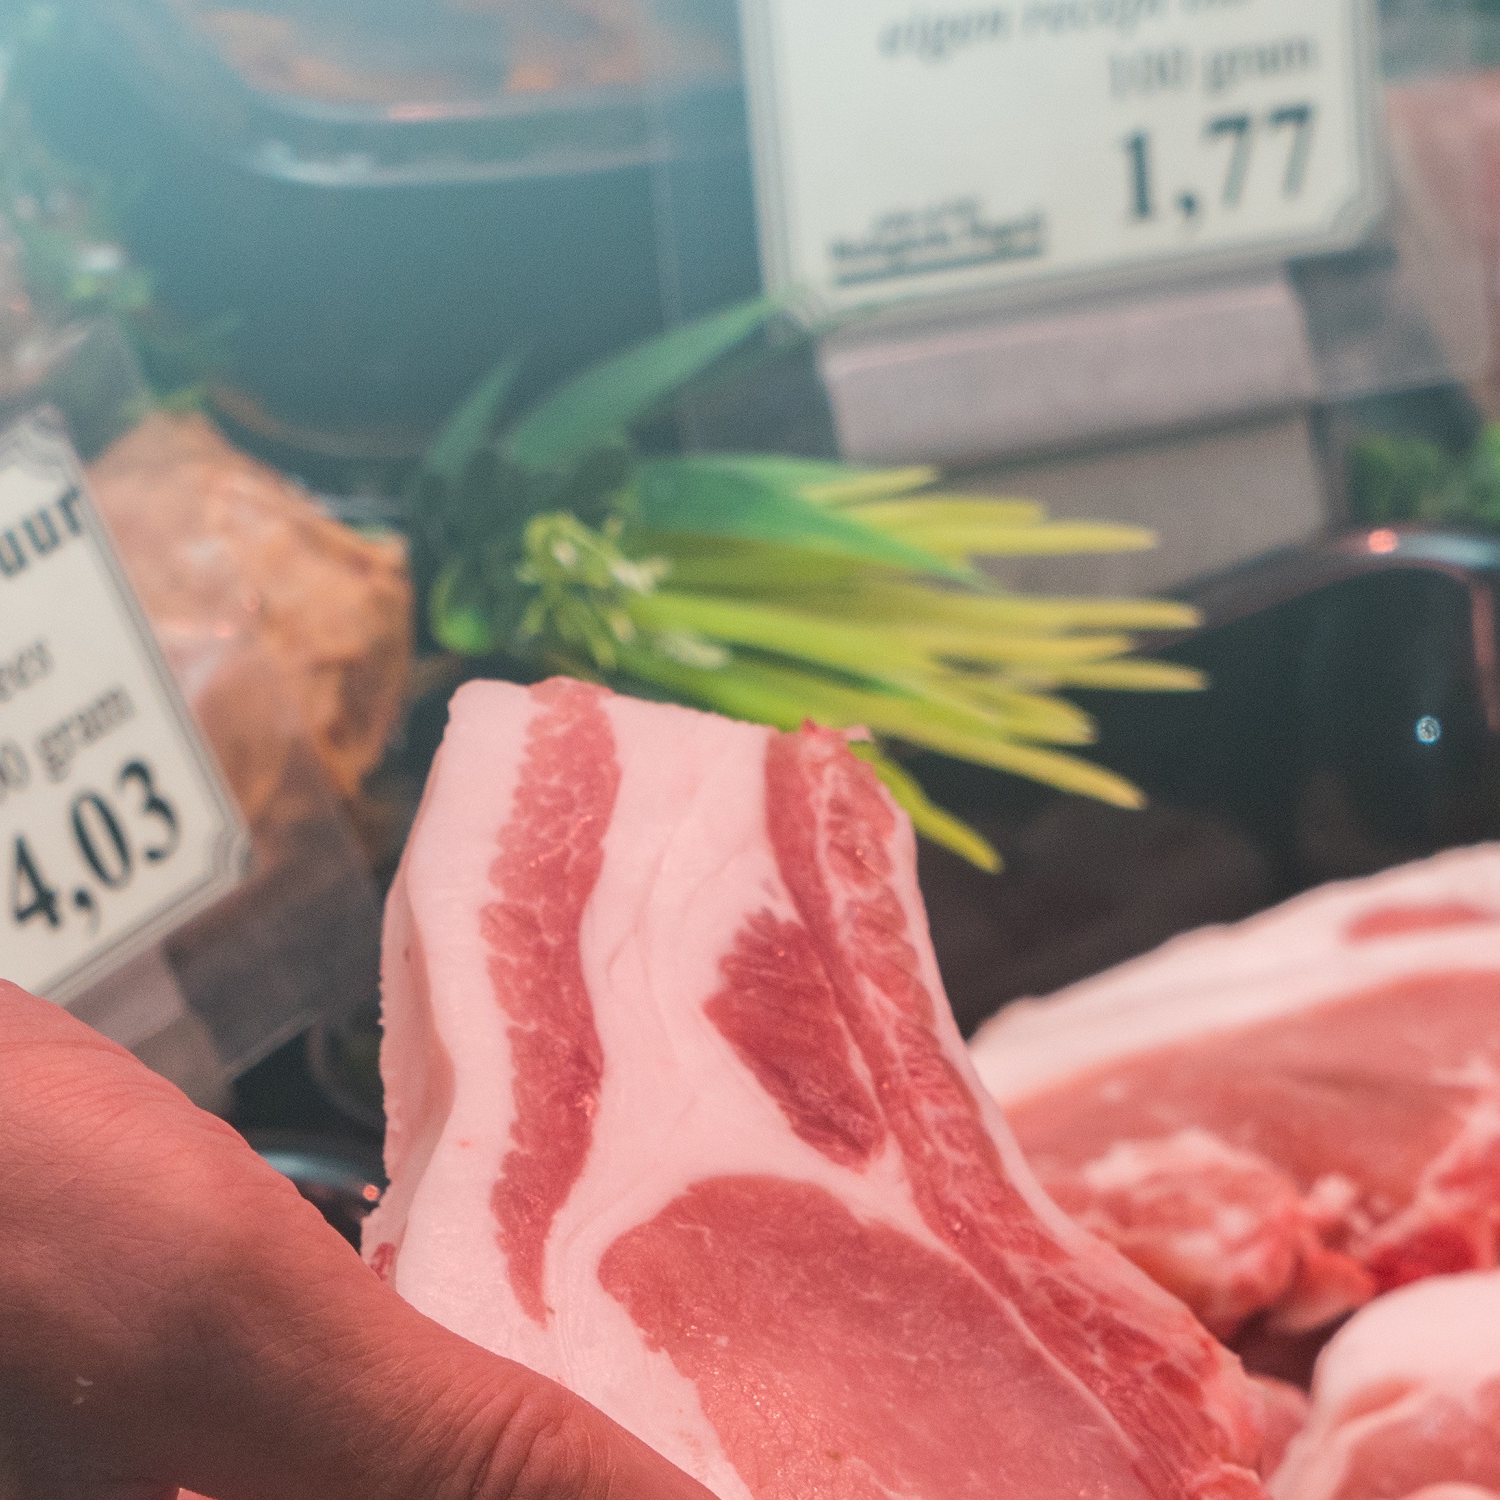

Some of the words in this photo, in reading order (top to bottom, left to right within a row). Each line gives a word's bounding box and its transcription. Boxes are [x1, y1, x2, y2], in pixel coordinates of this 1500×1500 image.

[1119, 103, 1313, 222] 1,77
[35, 683, 137, 784] gram
[11, 756, 182, 938] 4,03
